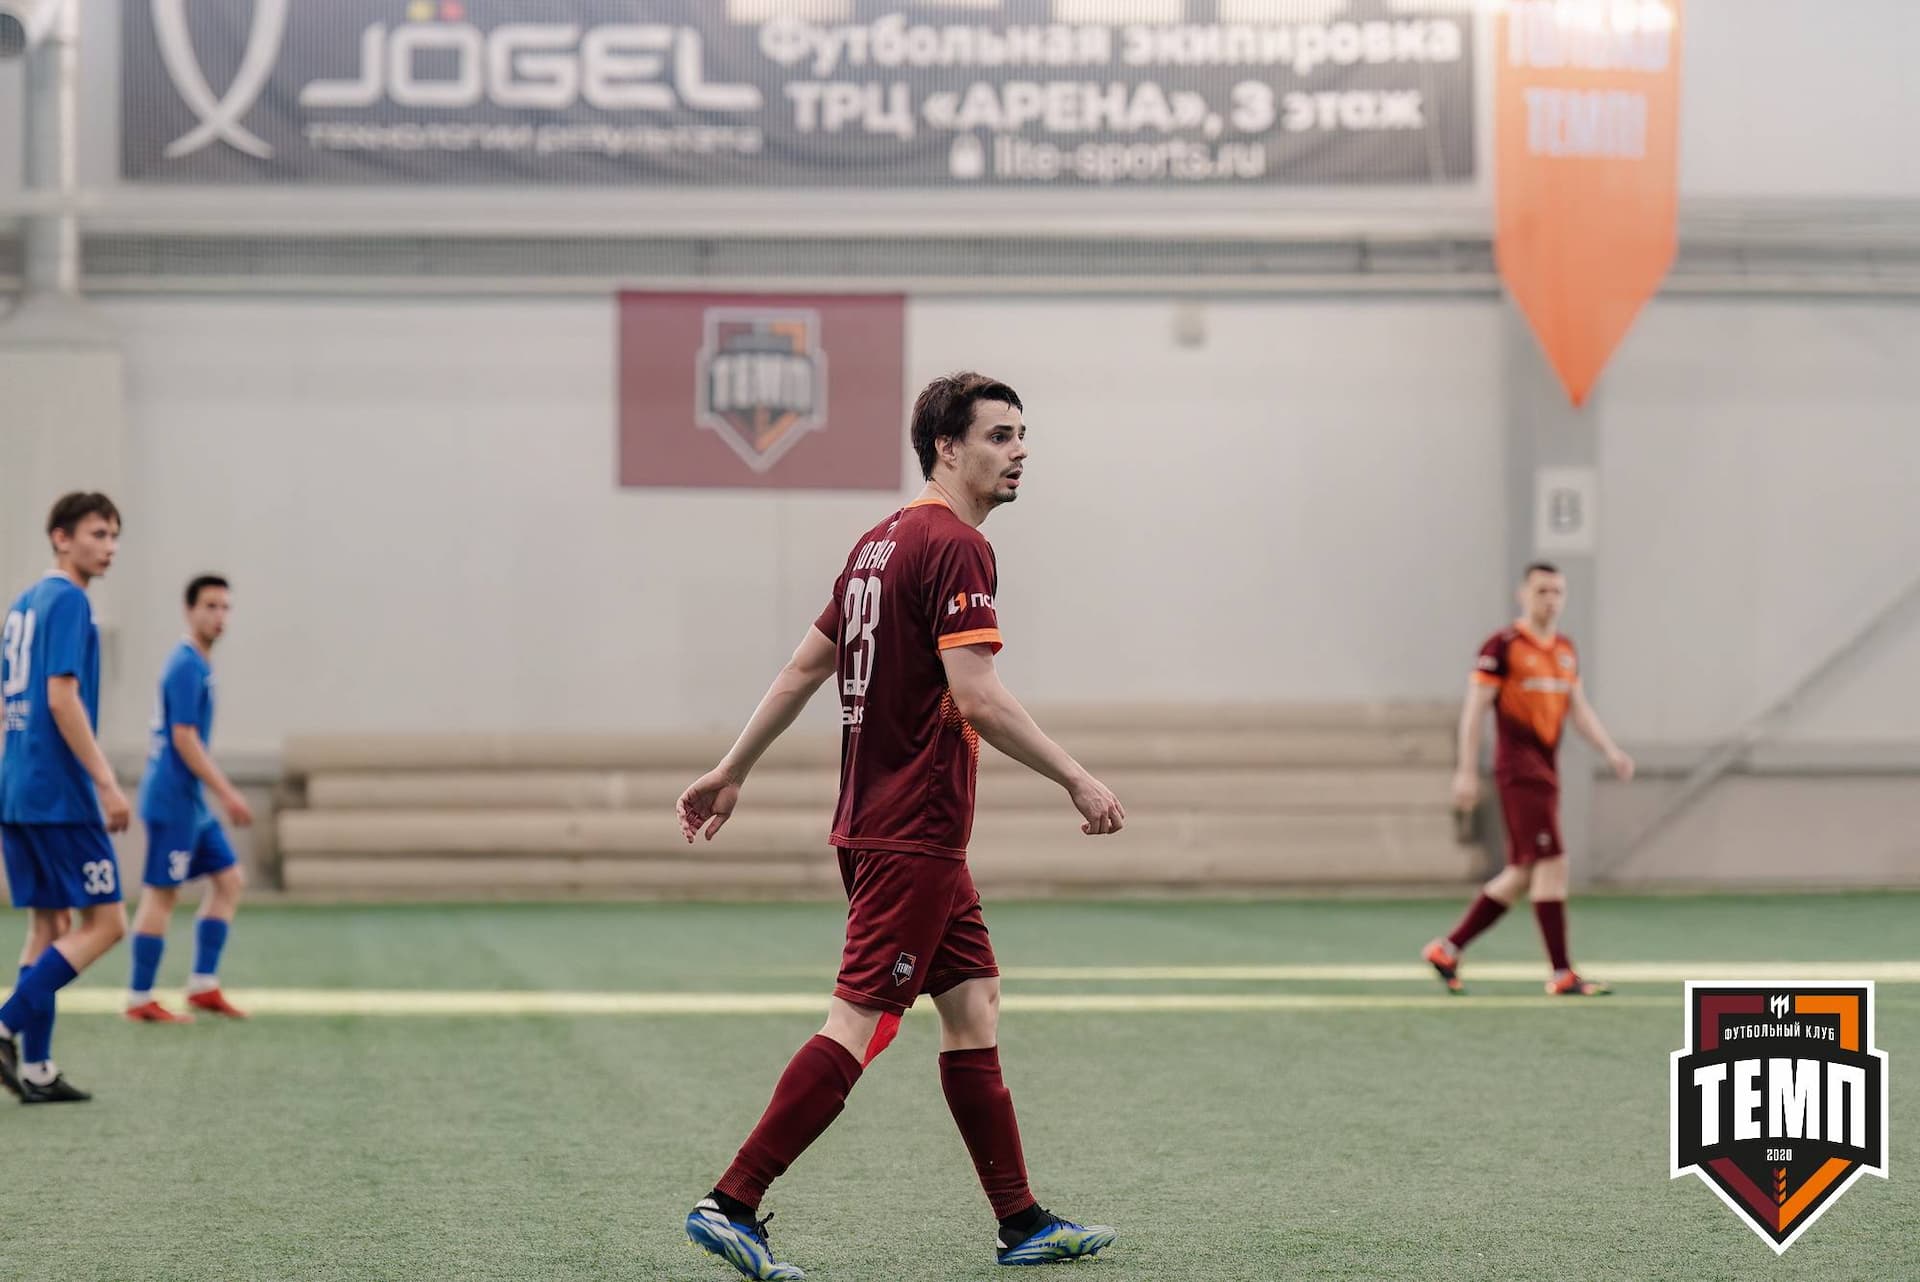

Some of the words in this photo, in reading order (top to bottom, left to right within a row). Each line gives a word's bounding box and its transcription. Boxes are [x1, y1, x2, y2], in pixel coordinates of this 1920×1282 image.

[300, 2, 763, 111] JÖGEL
[759, 12, 1111, 76] Футбольная
[1123, 20, 1461, 76] экипировка
[784, 81, 914, 141] ТРЦ
[1231, 80, 1274, 132] 3
[1282, 89, 1424, 131] этаж
[995, 134, 1265, 178] lite-sports.ru
[843, 575, 881, 696] 23
[83, 859, 115, 895] 33
